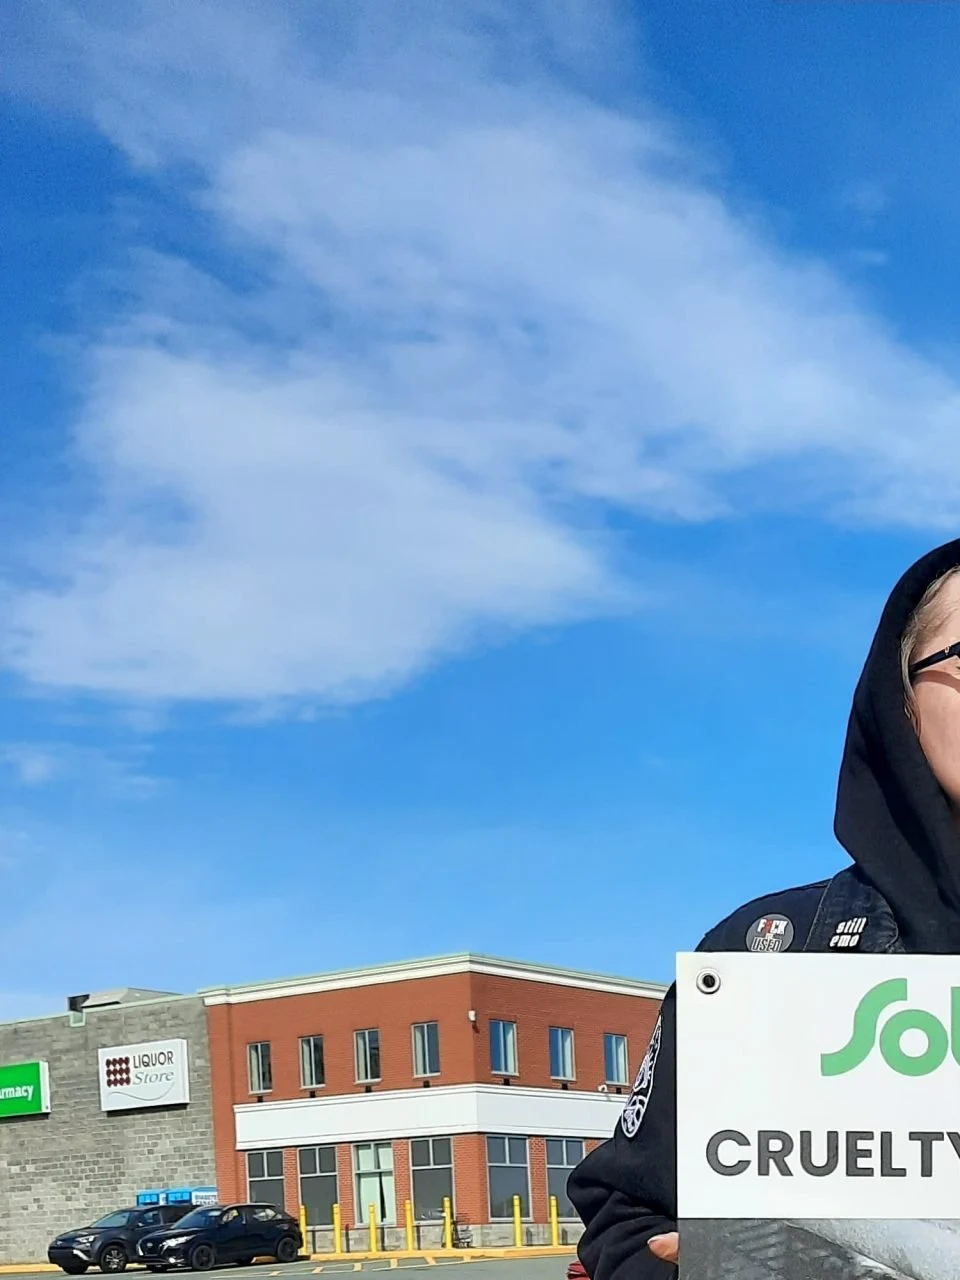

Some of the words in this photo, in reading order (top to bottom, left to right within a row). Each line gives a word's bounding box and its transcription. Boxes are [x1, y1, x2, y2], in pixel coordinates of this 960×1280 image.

[836, 918, 867, 934] still
[829, 934, 859, 947] emo
[133, 1051, 174, 1069] LIQUOR
[132, 1071, 175, 1086] Store
